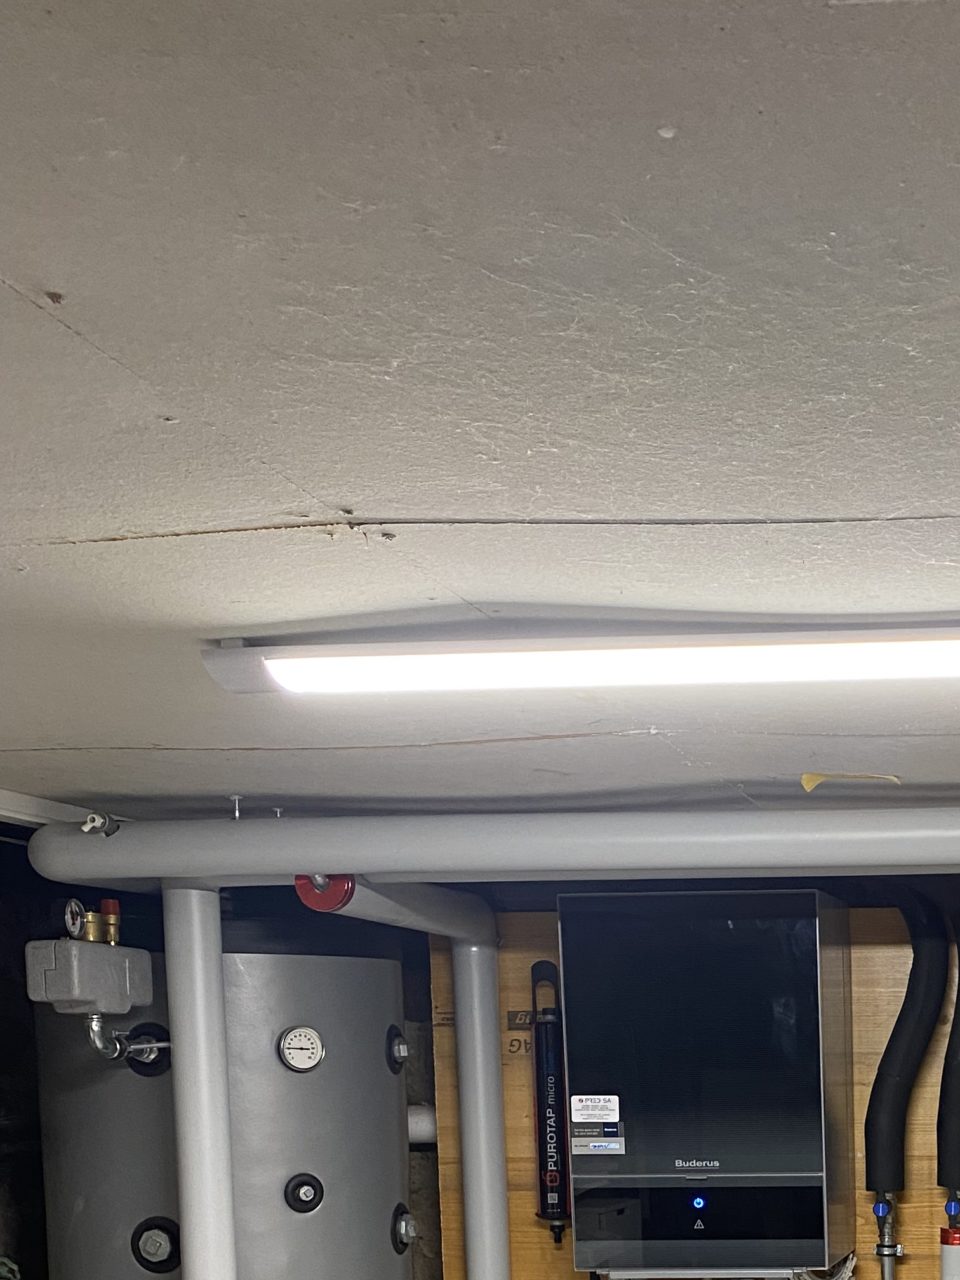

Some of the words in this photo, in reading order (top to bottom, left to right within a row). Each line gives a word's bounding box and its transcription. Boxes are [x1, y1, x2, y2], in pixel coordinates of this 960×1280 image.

[546, 1076, 555, 1105] micro
[546, 1108, 557, 1170] PUROTAP
[675, 1159, 720, 1167] Buderus
